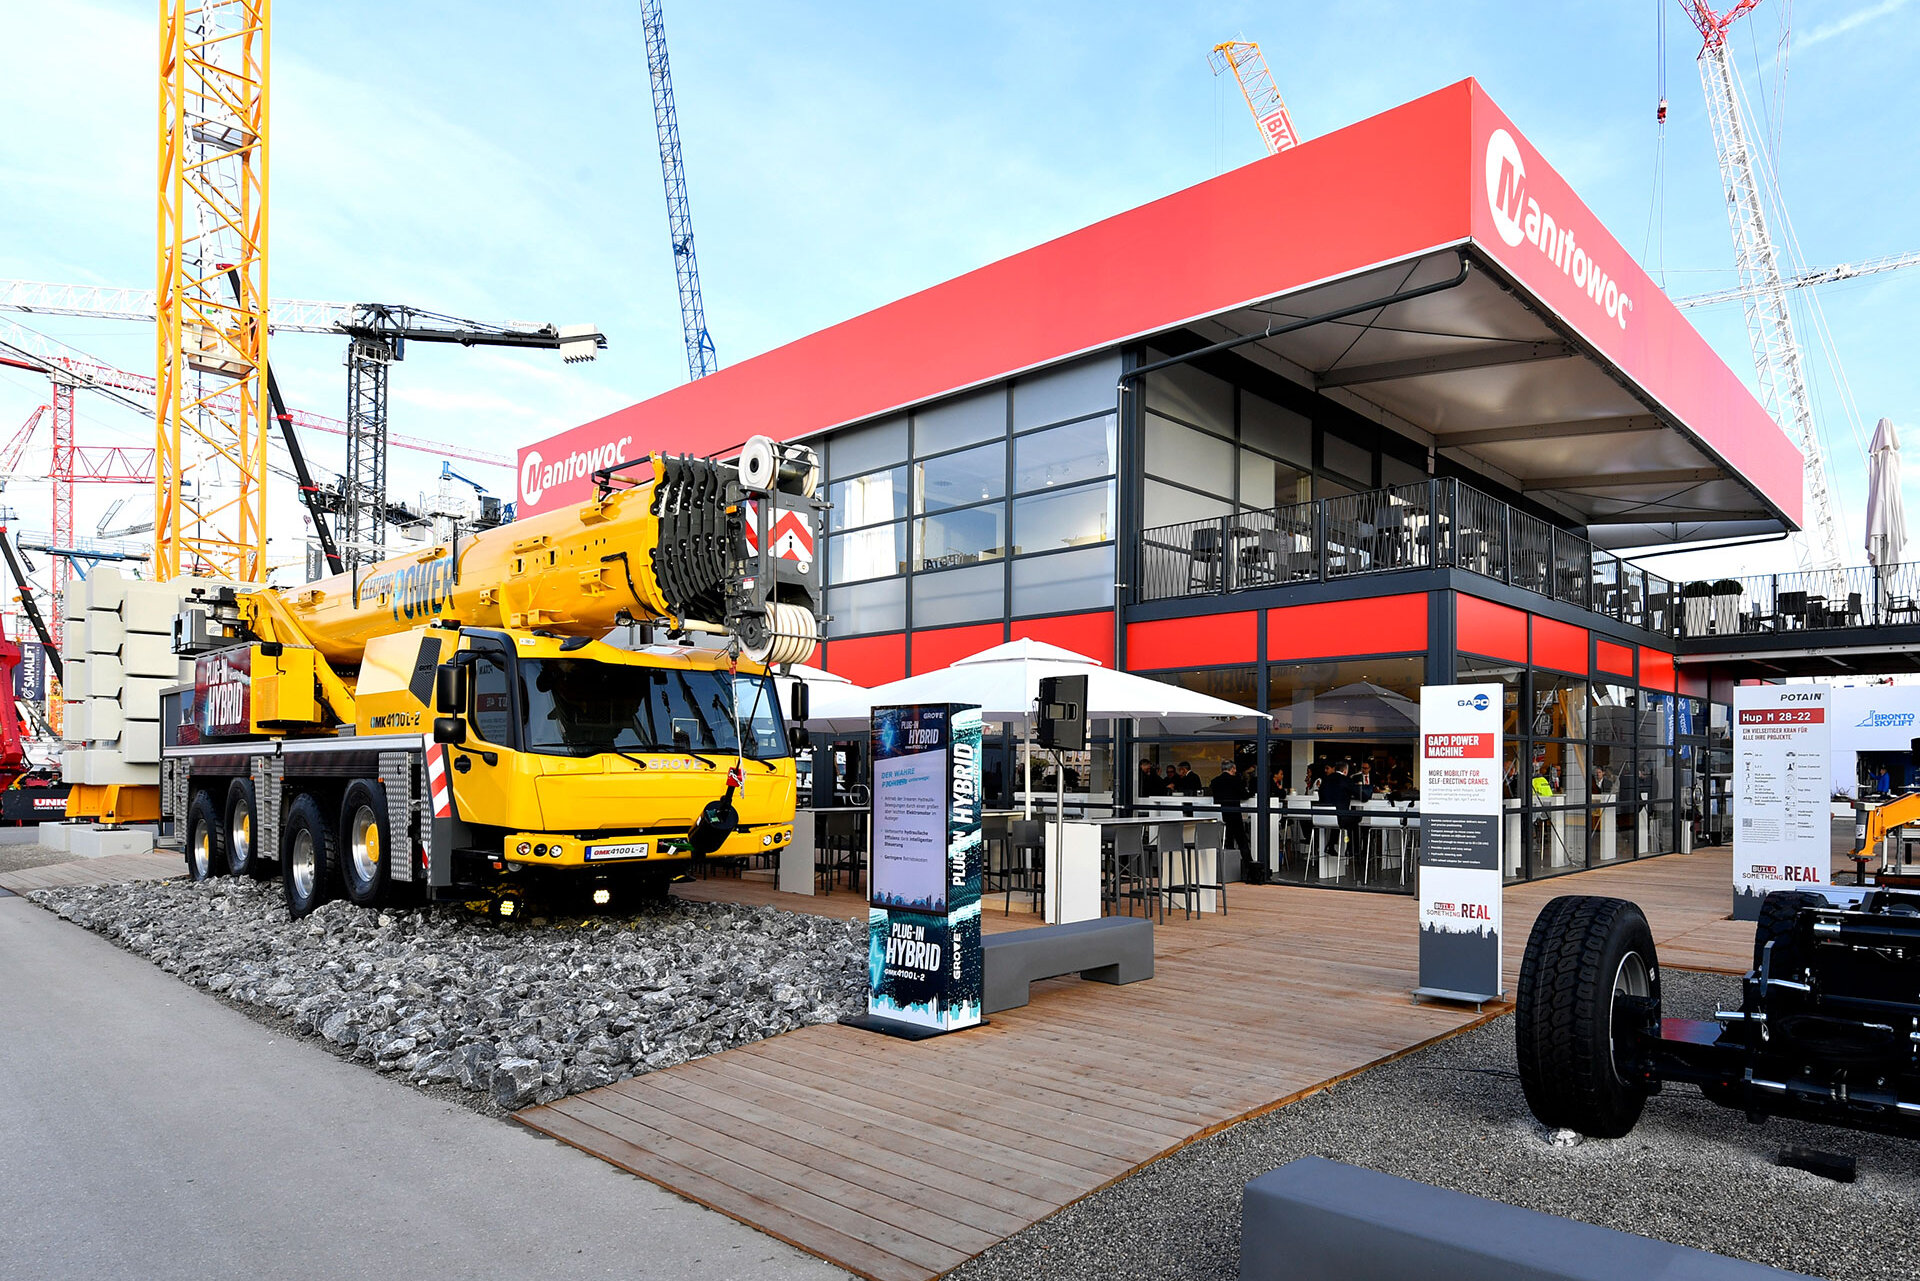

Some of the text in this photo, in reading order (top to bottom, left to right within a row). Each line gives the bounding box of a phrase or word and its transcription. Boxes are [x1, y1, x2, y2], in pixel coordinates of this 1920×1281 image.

[1486, 129, 1632, 329] Manitowoc
[521, 437, 631, 506] Manitowoc
[393, 556, 454, 622] POWER
[24, 644, 35, 687] SAHALIFT
[208, 682, 243, 726] HYBRID
[901, 721, 919, 729] PLUG-IN
[1743, 714, 1762, 722] Hup
[1768, 713, 1773, 721] M
[909, 729, 939, 744] HYBRID
[1429, 736, 1479, 745] GAPO POWER
[1429, 747, 1463, 756] MACHINE
[649, 759, 702, 769] GROVE
[895, 768, 914, 776] WAHRE
[953, 743, 974, 824] HYBRID
[594, 847, 644, 855] GMK4100L-2
[1785, 866, 1820, 882] REAL
[1426, 904, 1490, 920] SOMETHING REAL
[892, 923, 924, 941] PLUG-IN
[886, 937, 941, 971] HYBRID
